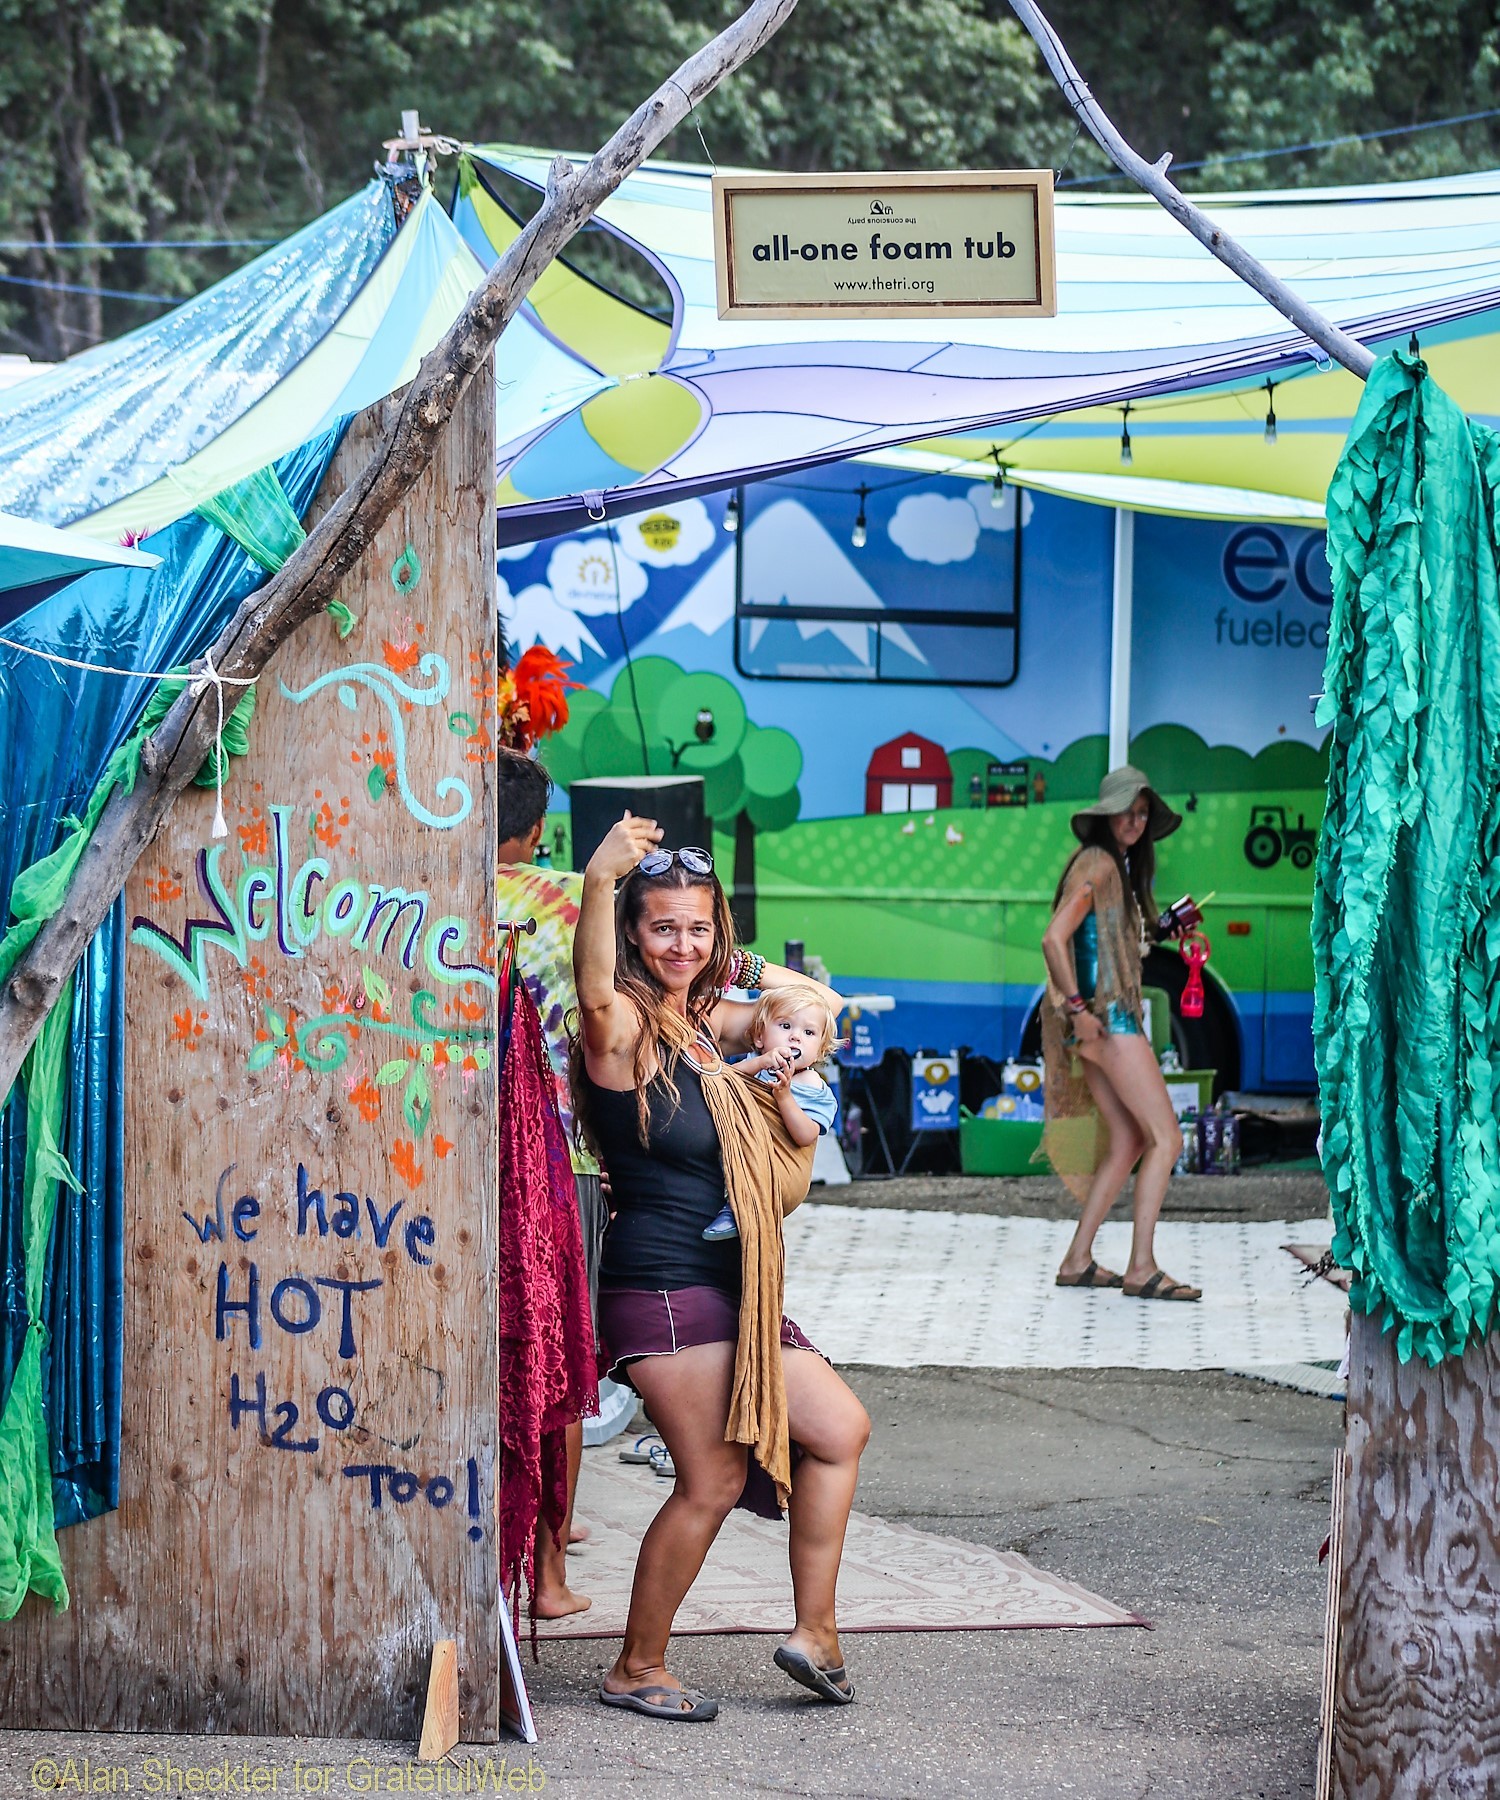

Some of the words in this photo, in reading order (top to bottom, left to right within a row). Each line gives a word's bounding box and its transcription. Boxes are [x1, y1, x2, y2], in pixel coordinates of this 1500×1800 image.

[752, 234, 859, 262] all-one
[869, 232, 953, 261] foam
[964, 231, 1016, 260] tub
[847, 216, 866, 225] party
[904, 217, 917, 225] the
[833, 276, 935, 294] www.thetri.org
[130, 803, 496, 1001] Welcome
[296, 1162, 436, 1266] have
[215, 1260, 384, 1360] HOT
[229, 1370, 356, 1454] H2O
